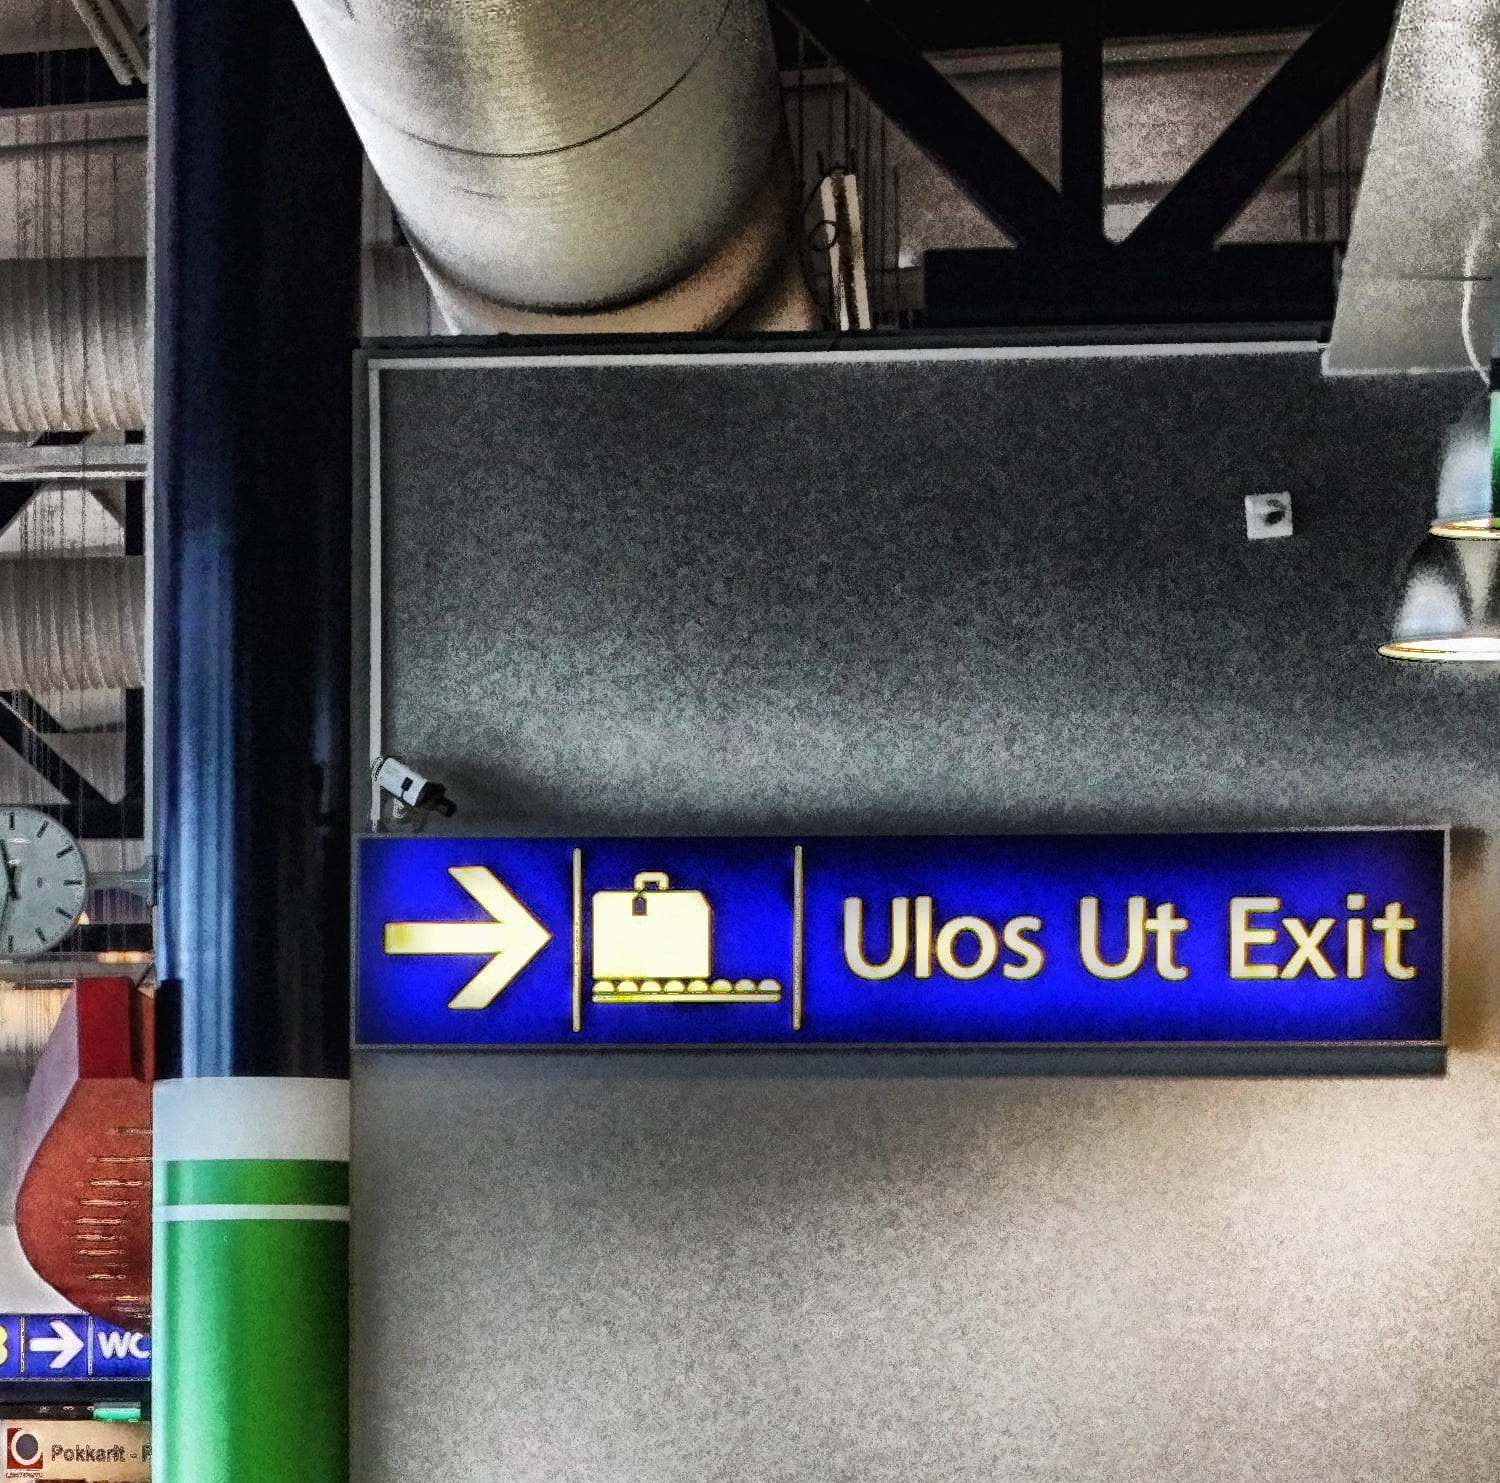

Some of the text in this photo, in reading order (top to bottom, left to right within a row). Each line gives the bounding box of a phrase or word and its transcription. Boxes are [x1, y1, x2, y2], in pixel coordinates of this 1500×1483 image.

[842, 892, 1418, 981] Ulos Ut Exit
[97, 1331, 151, 1359] WC
[51, 1444, 126, 1463] Pokkarit
